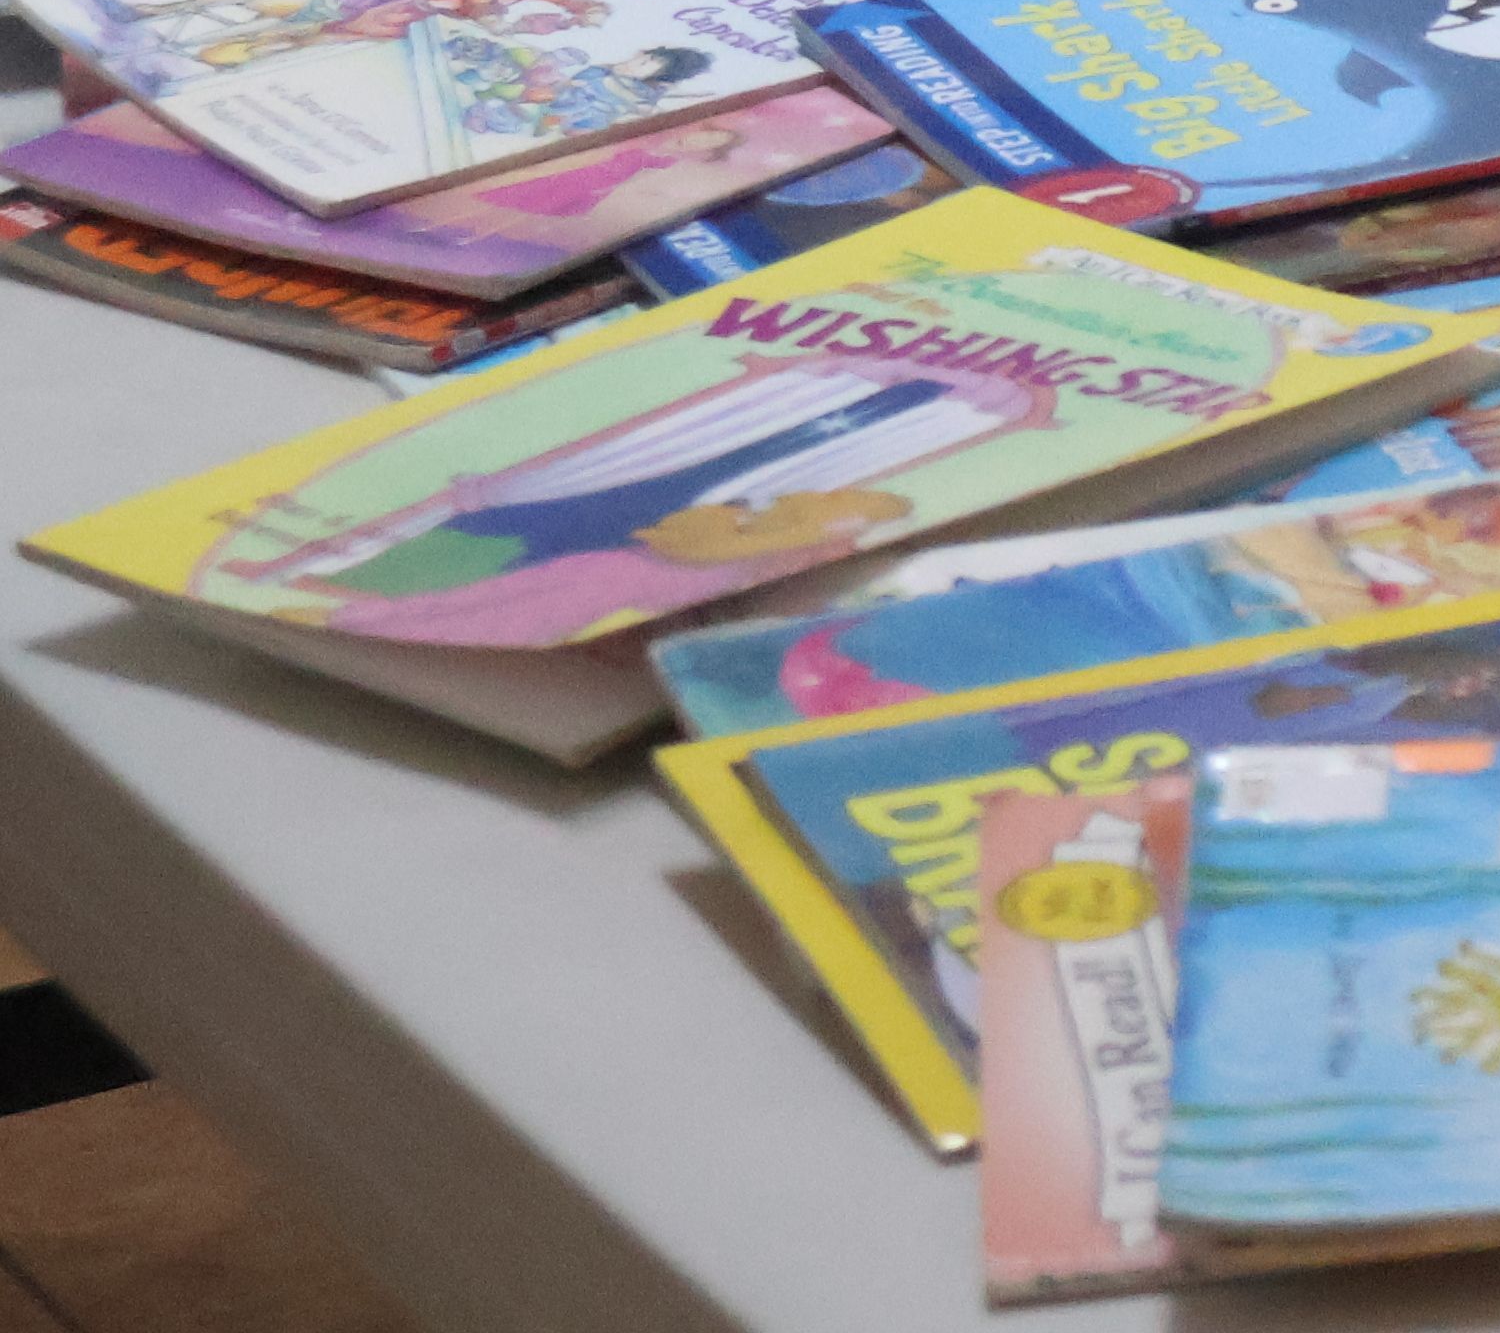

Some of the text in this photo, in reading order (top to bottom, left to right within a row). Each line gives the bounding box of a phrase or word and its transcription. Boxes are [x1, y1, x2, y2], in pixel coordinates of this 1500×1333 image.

[673, 6, 797, 62] Cupcakes
[860, 24, 976, 107] READING
[1125, 92, 1241, 160] Big
[1193, 60, 1312, 128] Little
[976, 127, 1055, 167] STEP
[1057, 183, 1133, 204] 1
[703, 296, 1117, 386] WISHING
[1078, 366, 1274, 421] STAR
